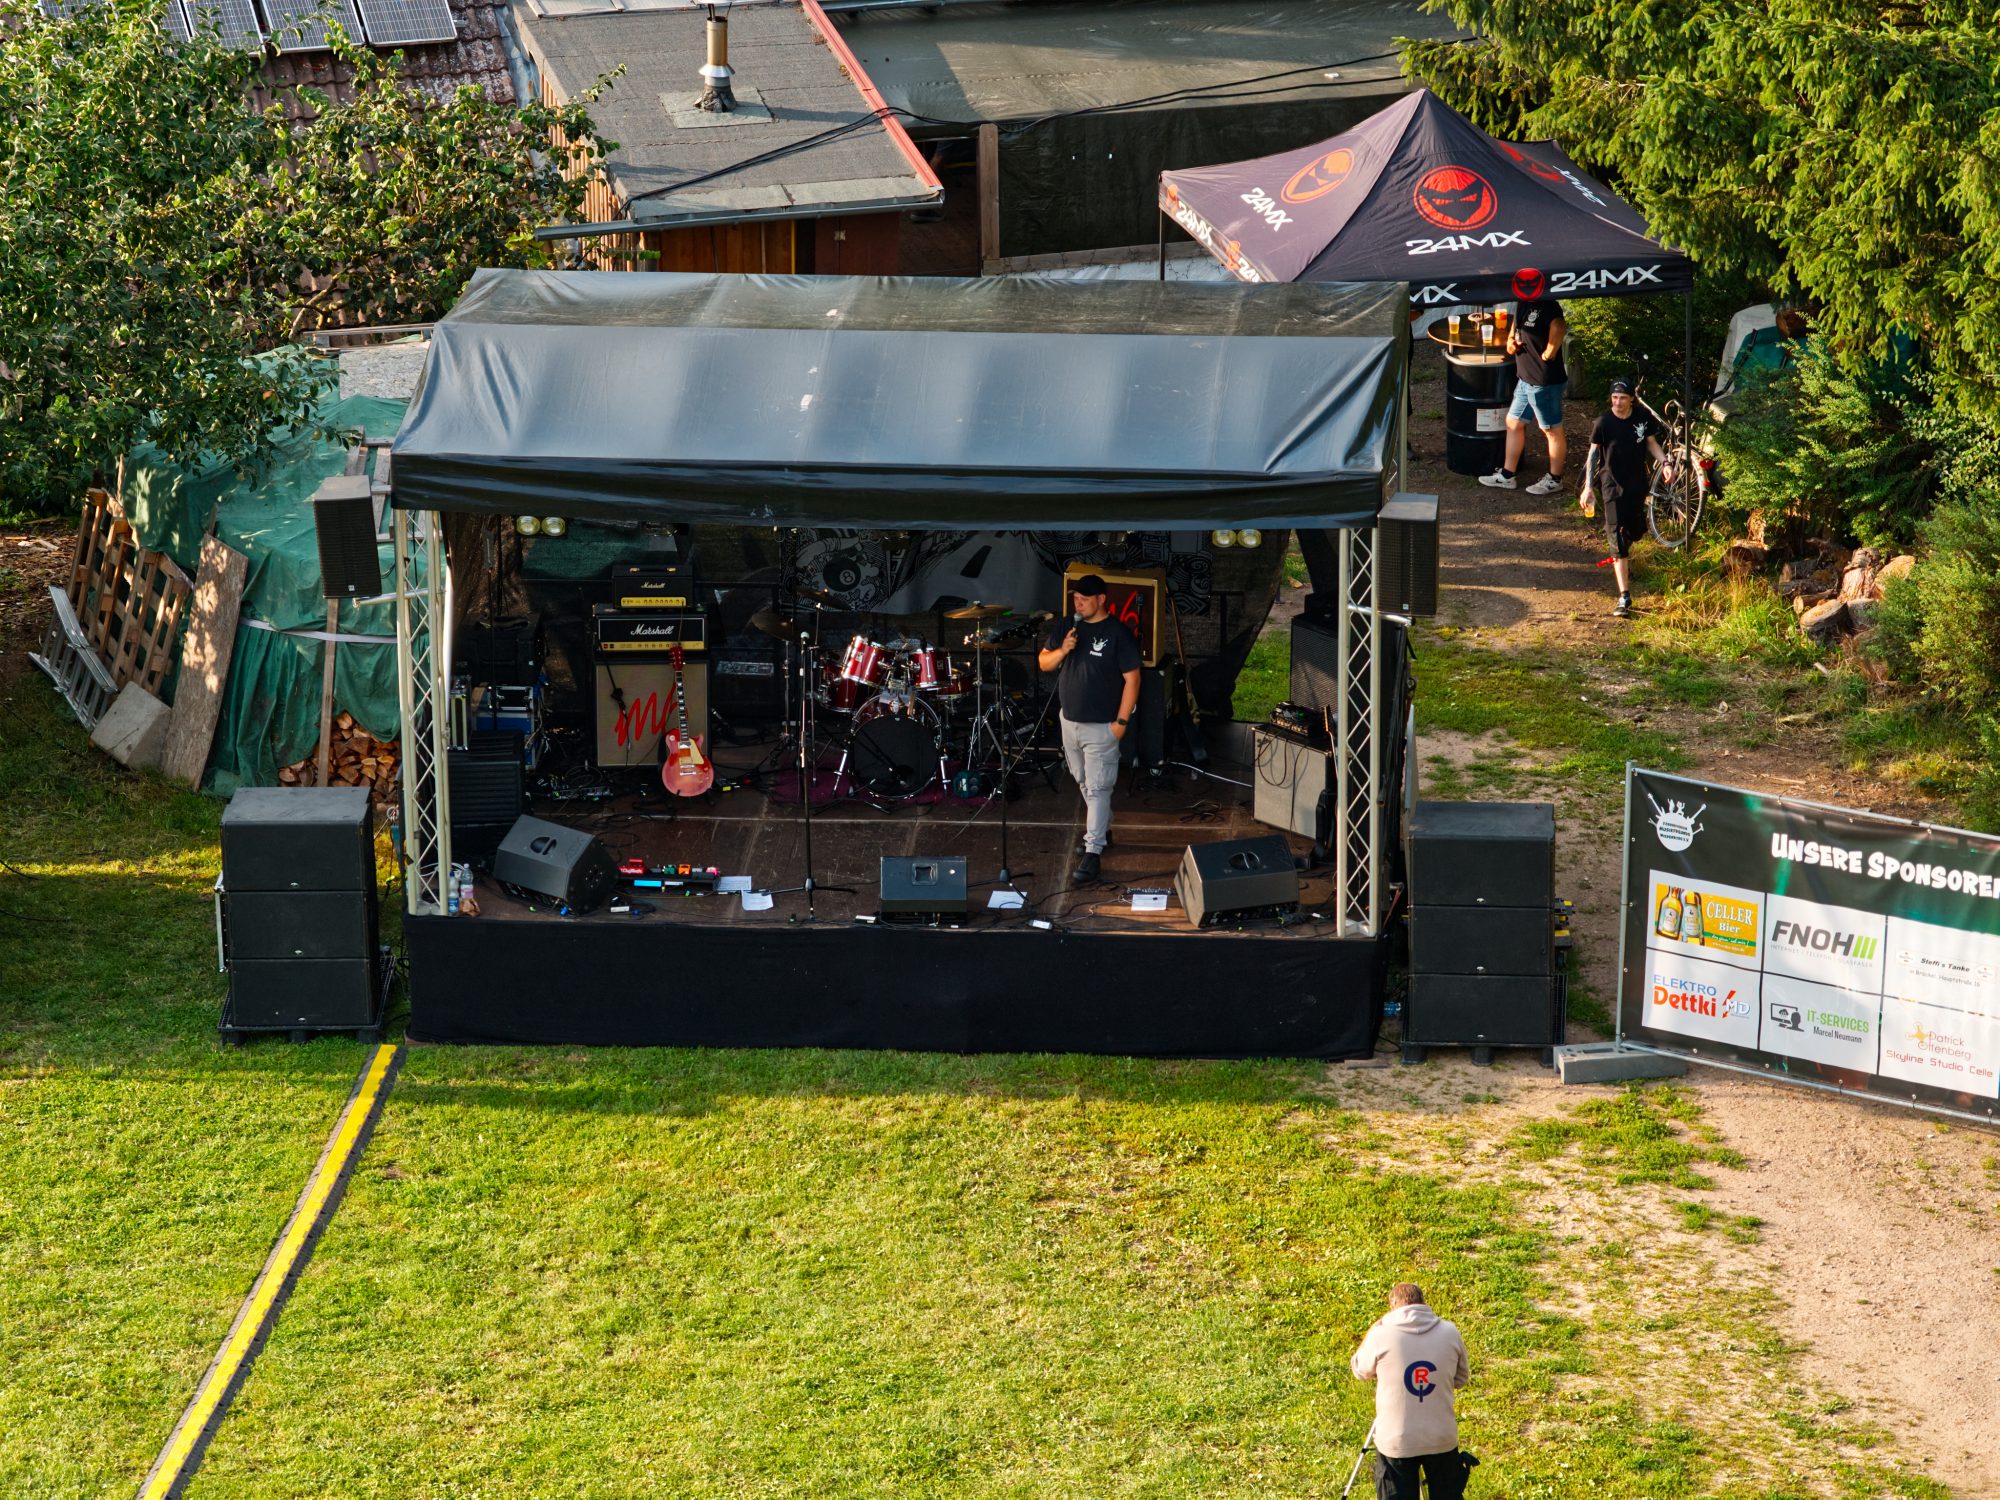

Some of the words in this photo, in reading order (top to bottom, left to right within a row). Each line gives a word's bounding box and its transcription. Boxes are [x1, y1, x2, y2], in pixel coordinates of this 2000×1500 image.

[1240, 187, 1294, 232] 24MX
[1405, 230, 1532, 256] 24MX
[1550, 264, 1664, 293] 24MX
[641, 581, 667, 589] Marshall
[630, 623, 675, 636] Marshall
[1771, 832, 1863, 874] UNSERE
[1706, 901, 1753, 926] CELLER
[1719, 922, 1741, 933] Bier
[1653, 974, 1717, 997] ELEKTRO
[1653, 985, 1717, 1017] Dettki
[1807, 1009, 1870, 1033] IT-SERVICES
[1813, 1026, 1834, 1038] Marcel
[1834, 1031, 1863, 1044] Neumann
[1886, 1049, 1924, 1064] Skyline
[1930, 1057, 1964, 1073] Studio
[1969, 1065, 1994, 1078] Celle
